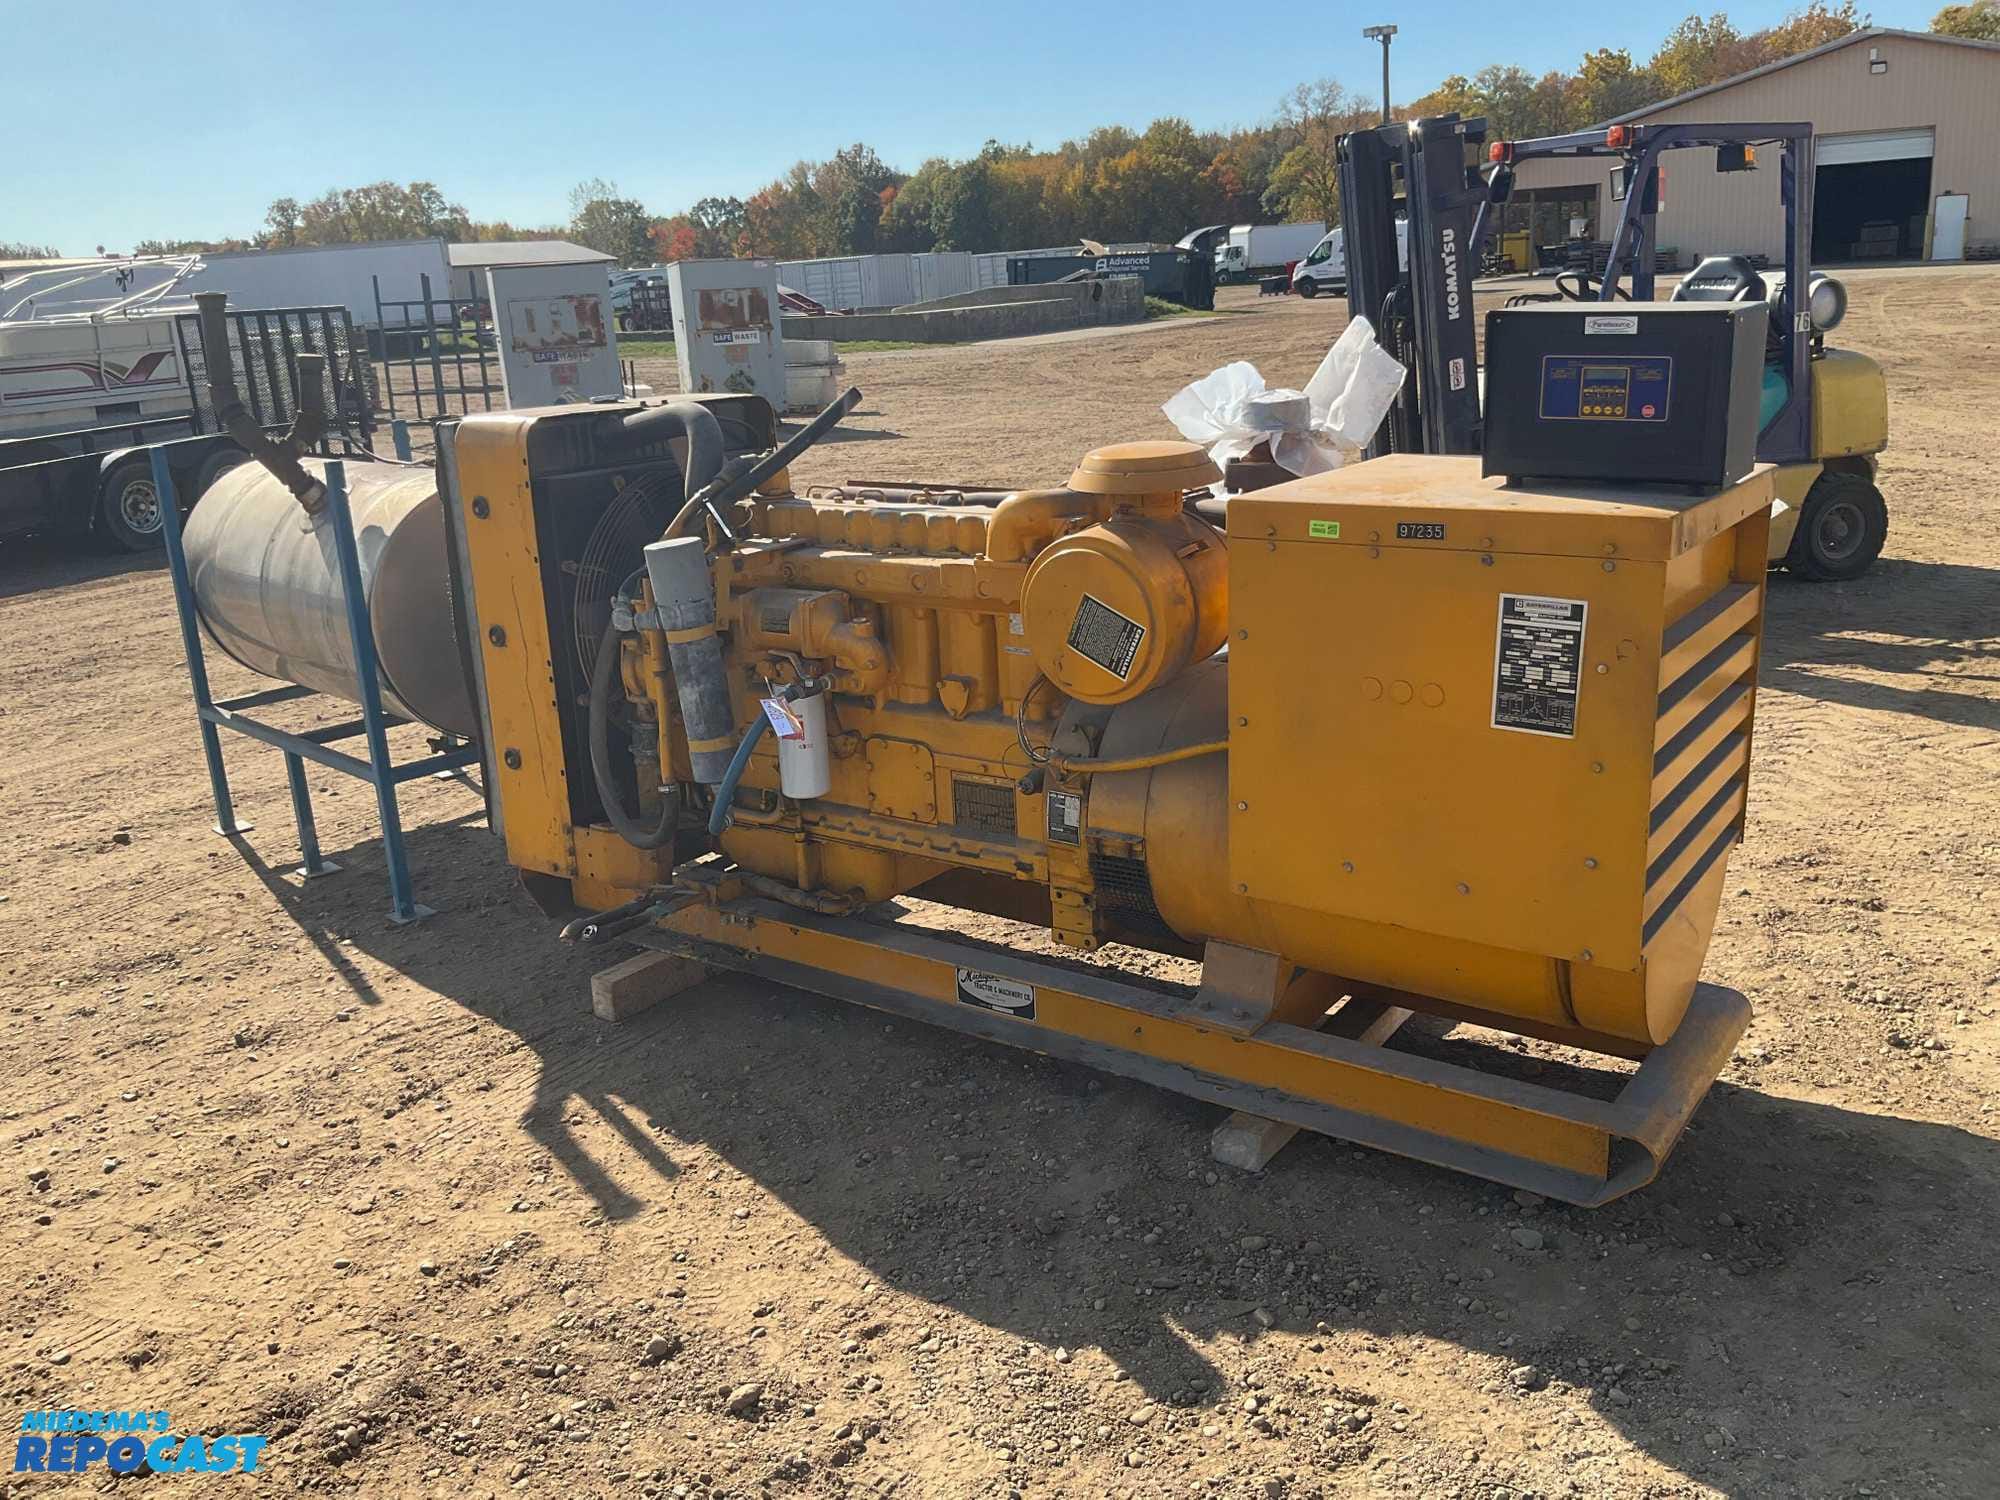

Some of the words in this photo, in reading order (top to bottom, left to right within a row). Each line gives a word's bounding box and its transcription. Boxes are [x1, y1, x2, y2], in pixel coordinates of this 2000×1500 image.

[1109, 256, 1150, 265] Advanced
[1441, 228, 1460, 320] KOMATSU
[1796, 313, 1809, 330] 76
[714, 333, 732, 342] SAFE
[1400, 525, 1442, 538] 97235
[974, 981, 993, 993] TRACTOR
